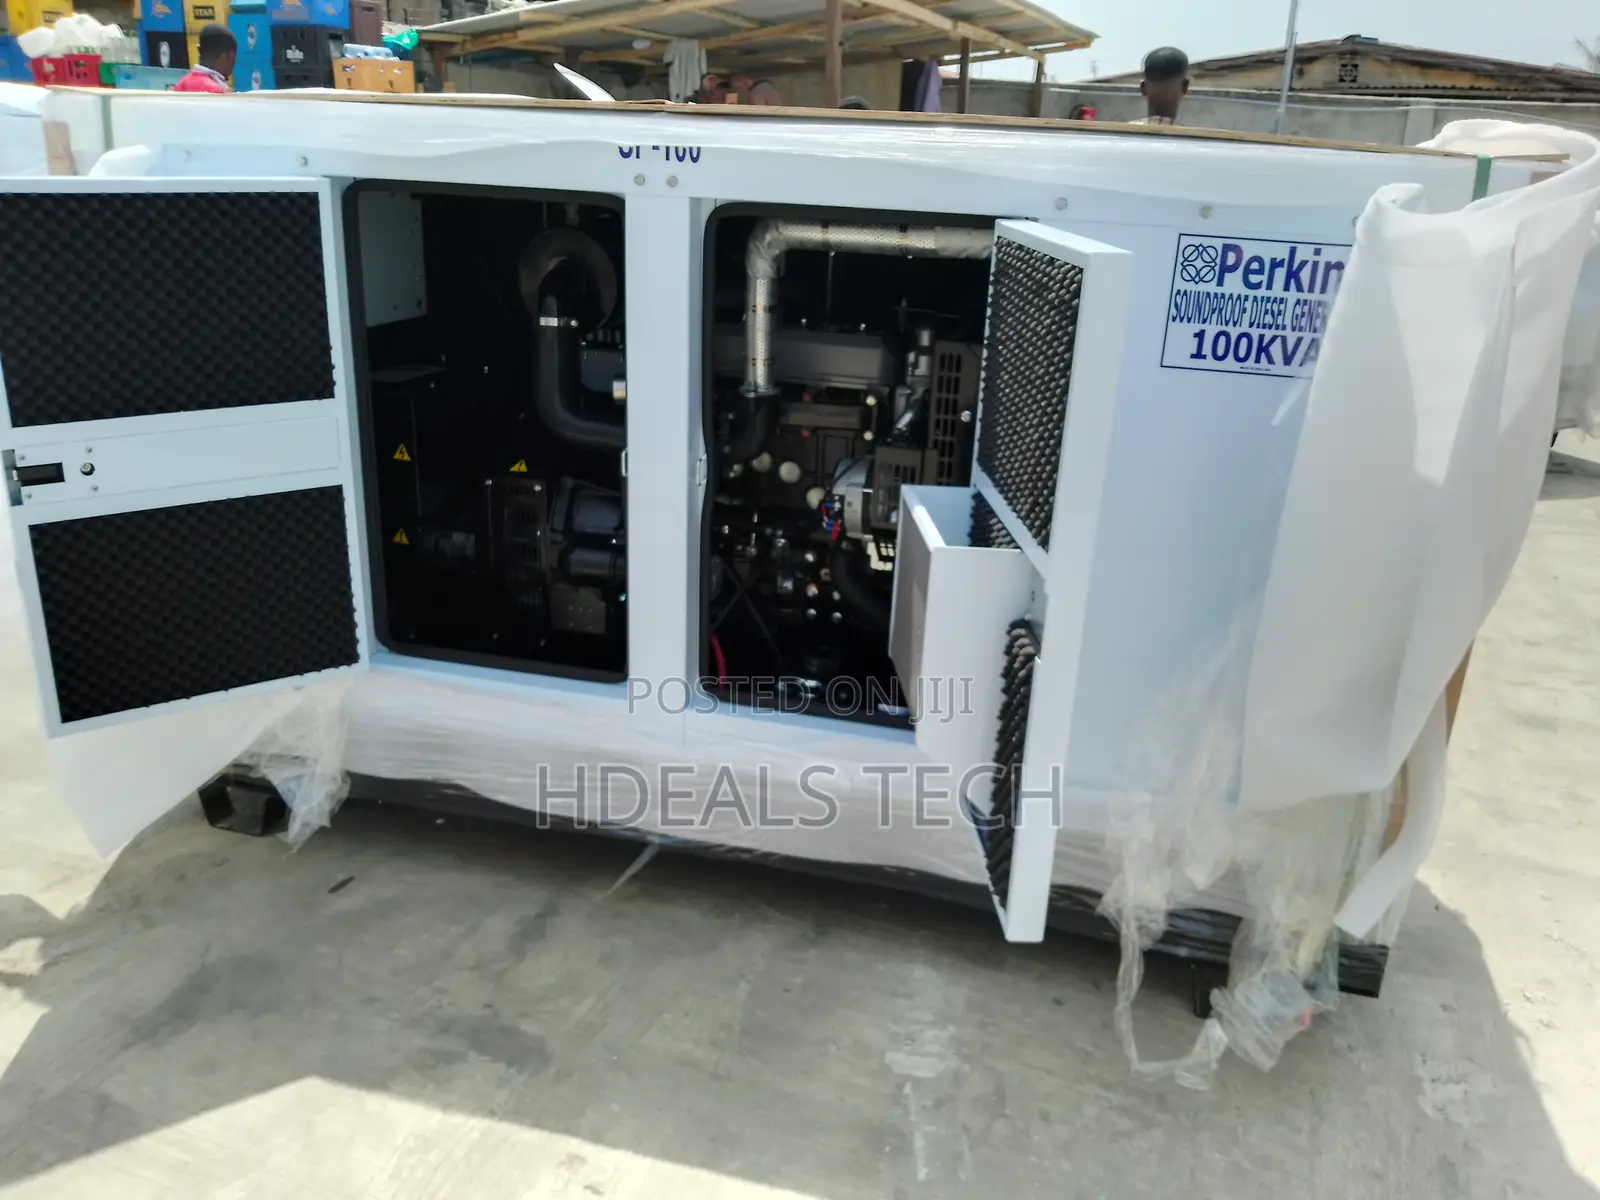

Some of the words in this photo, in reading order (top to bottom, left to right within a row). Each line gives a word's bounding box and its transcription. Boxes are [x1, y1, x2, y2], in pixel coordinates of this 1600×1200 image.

[1171, 289, 1249, 327] SOUNDPROOF
[1249, 295, 1288, 331] DIESEL
[1190, 329, 1321, 368] 100KVA
